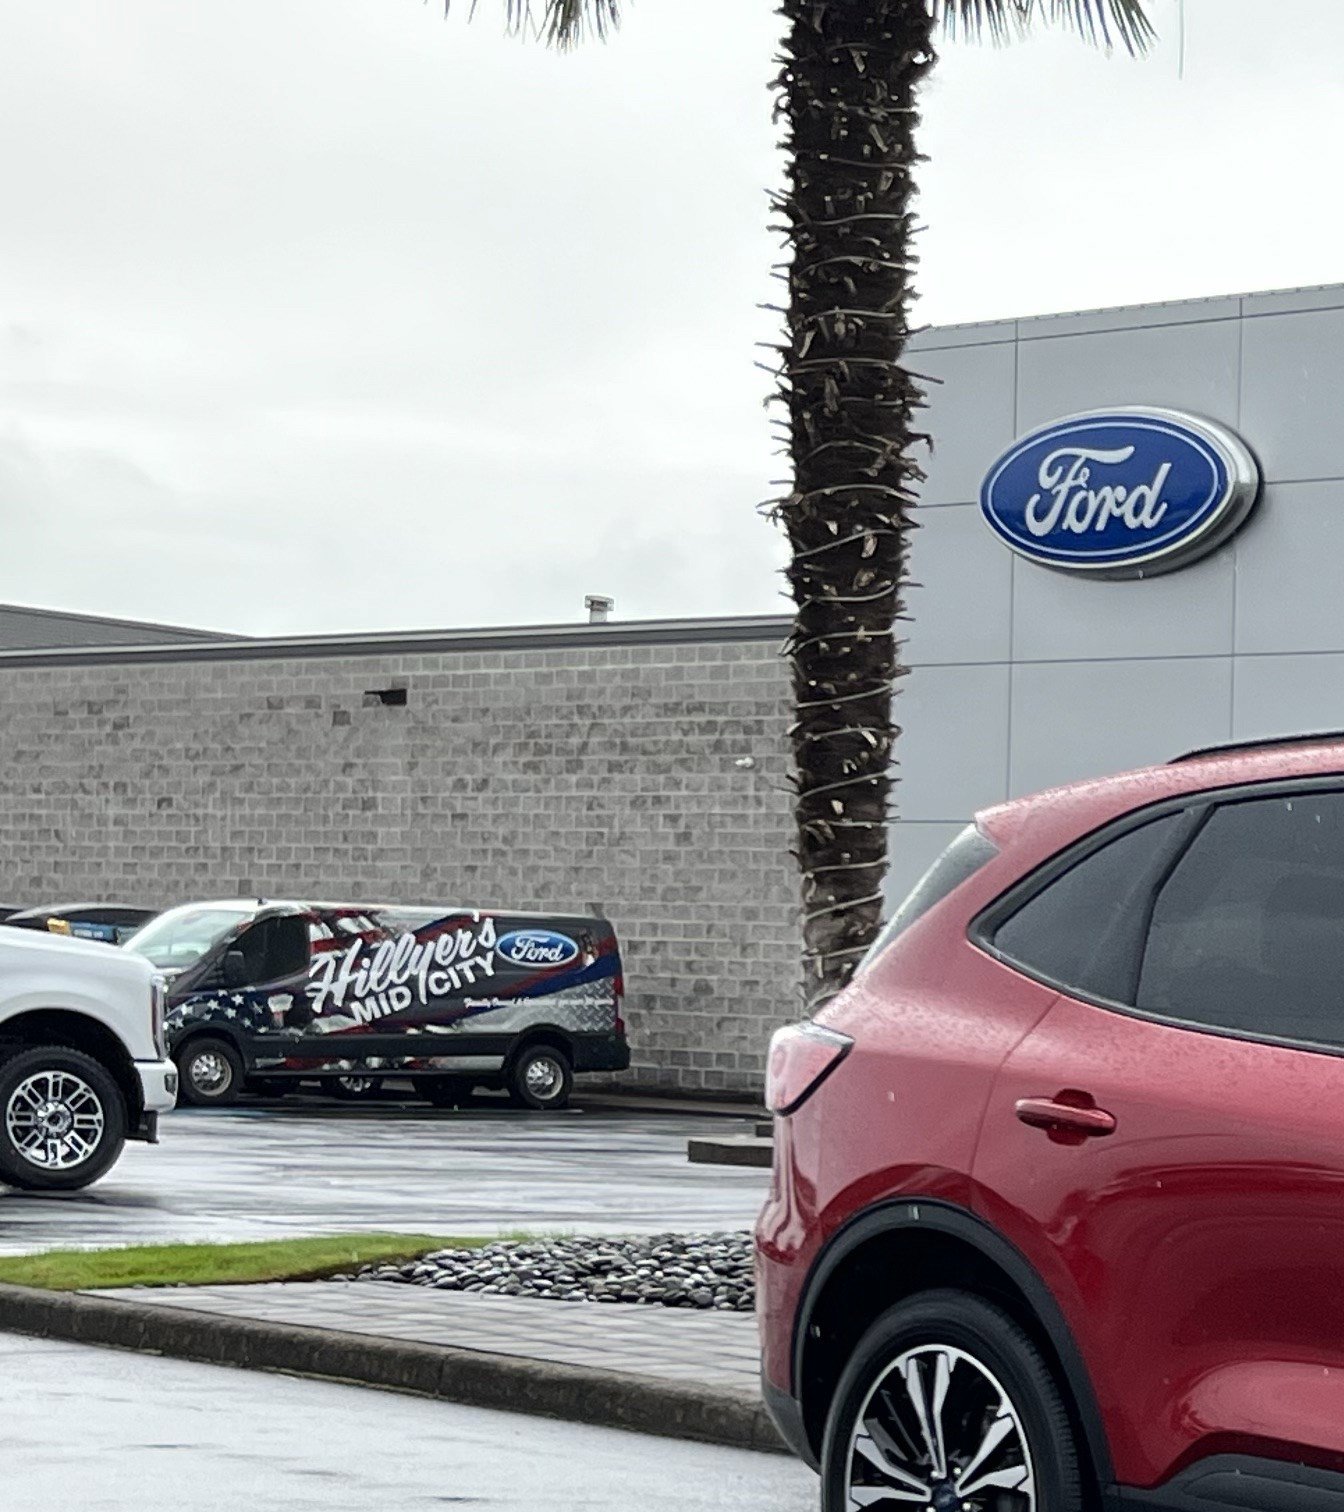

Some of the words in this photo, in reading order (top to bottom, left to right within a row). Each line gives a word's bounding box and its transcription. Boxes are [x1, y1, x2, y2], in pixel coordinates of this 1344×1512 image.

[1025, 446, 1171, 536] Ford
[306, 910, 497, 1013] Hillyer's
[350, 986, 412, 1026] MID
[428, 950, 496, 996] CITY
[511, 935, 564, 962] Ford
